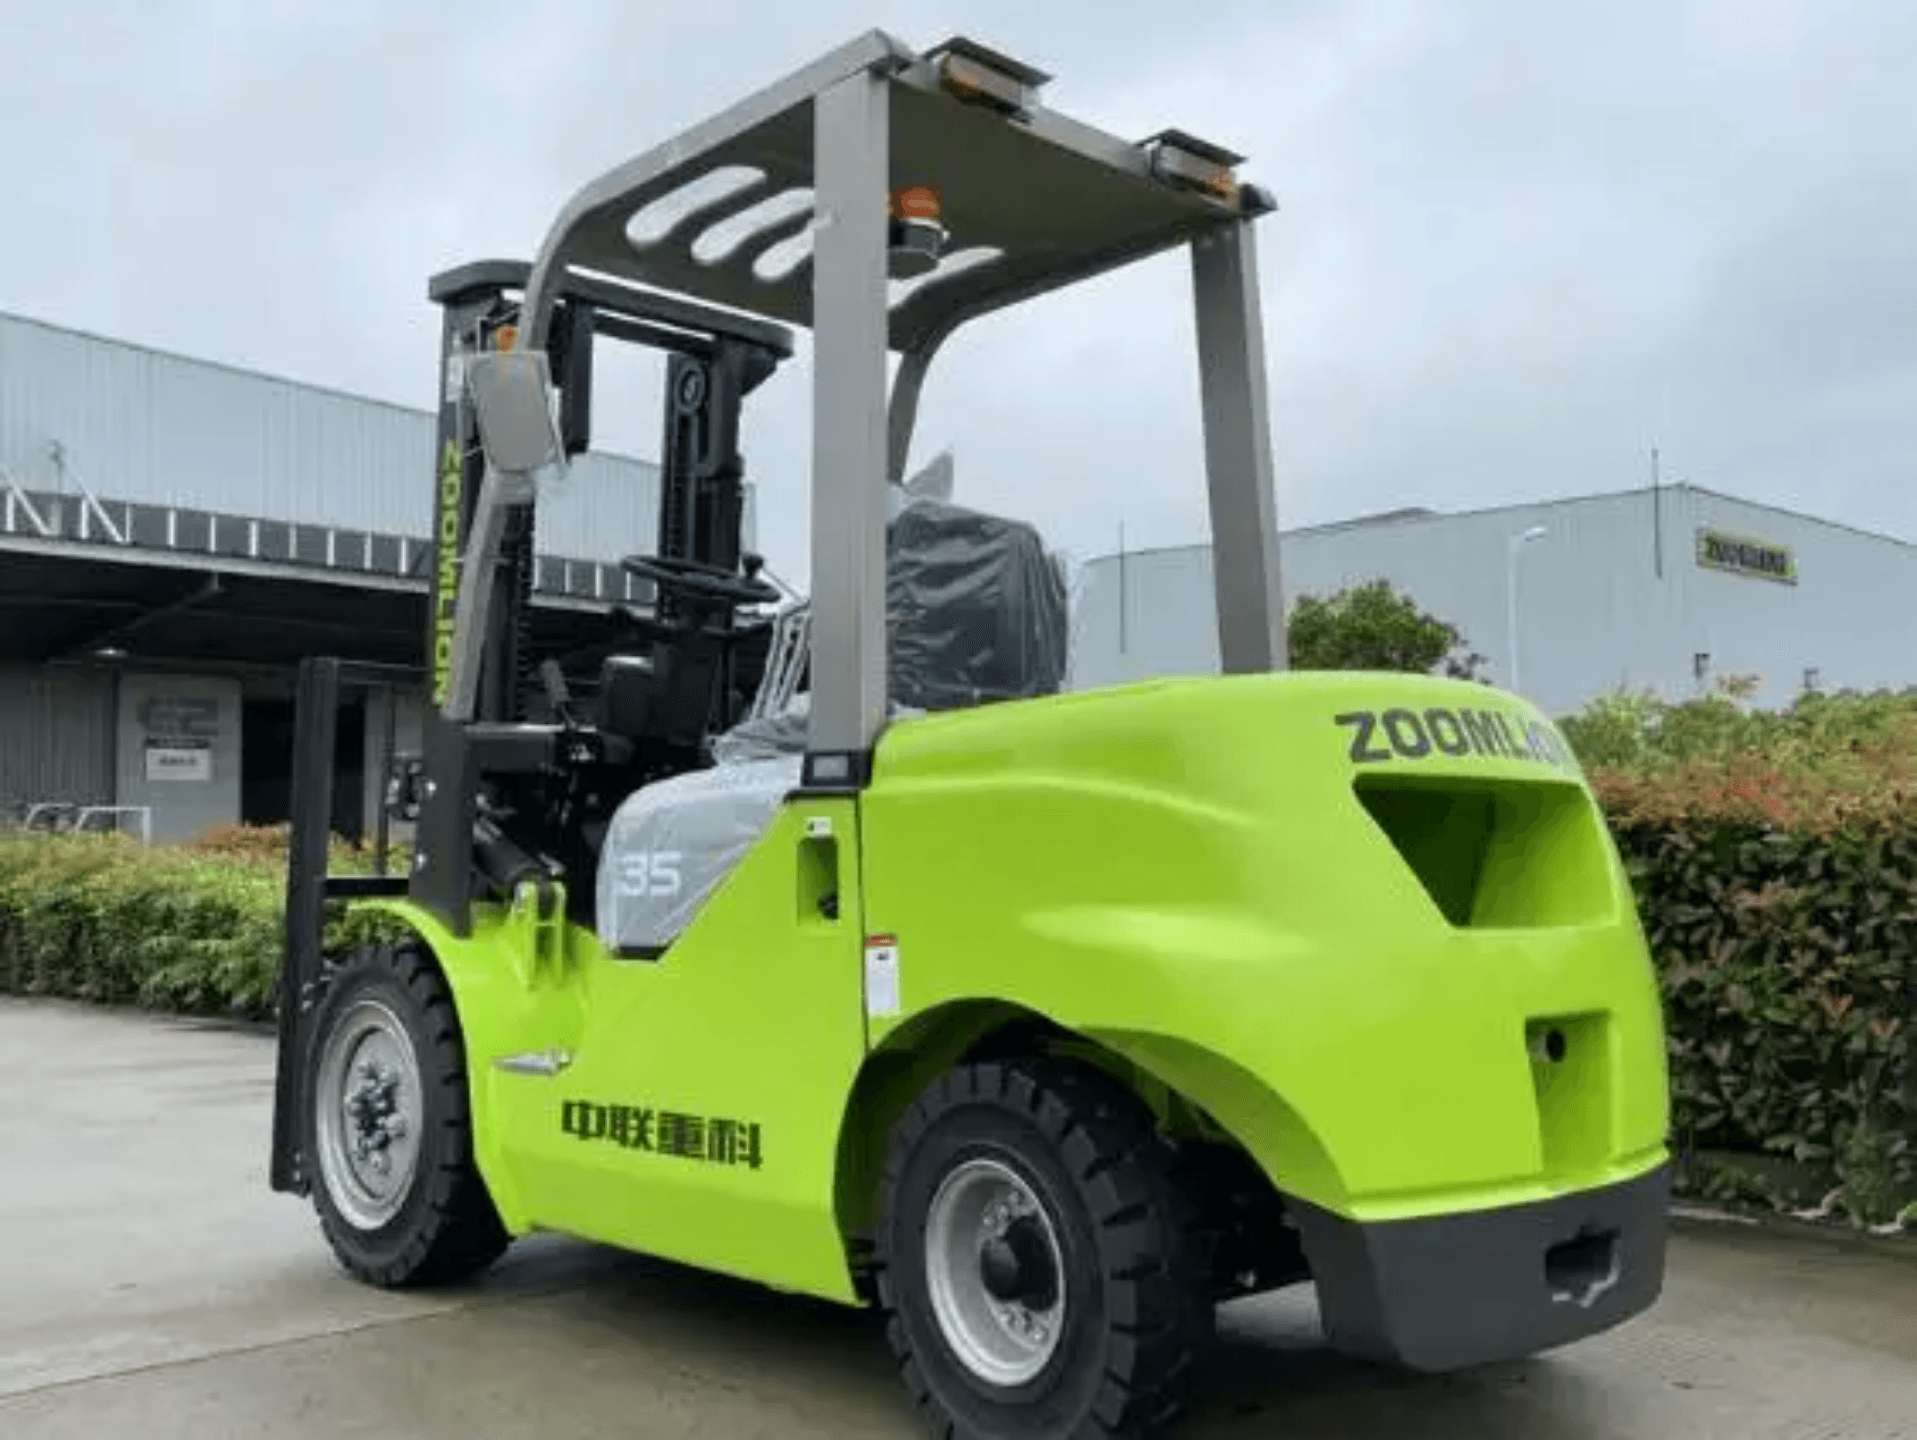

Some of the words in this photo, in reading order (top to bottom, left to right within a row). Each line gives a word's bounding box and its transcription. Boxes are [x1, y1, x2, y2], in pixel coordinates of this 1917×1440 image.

[613, 851, 682, 897] 35
[561, 1099, 762, 1169] 中联重科
